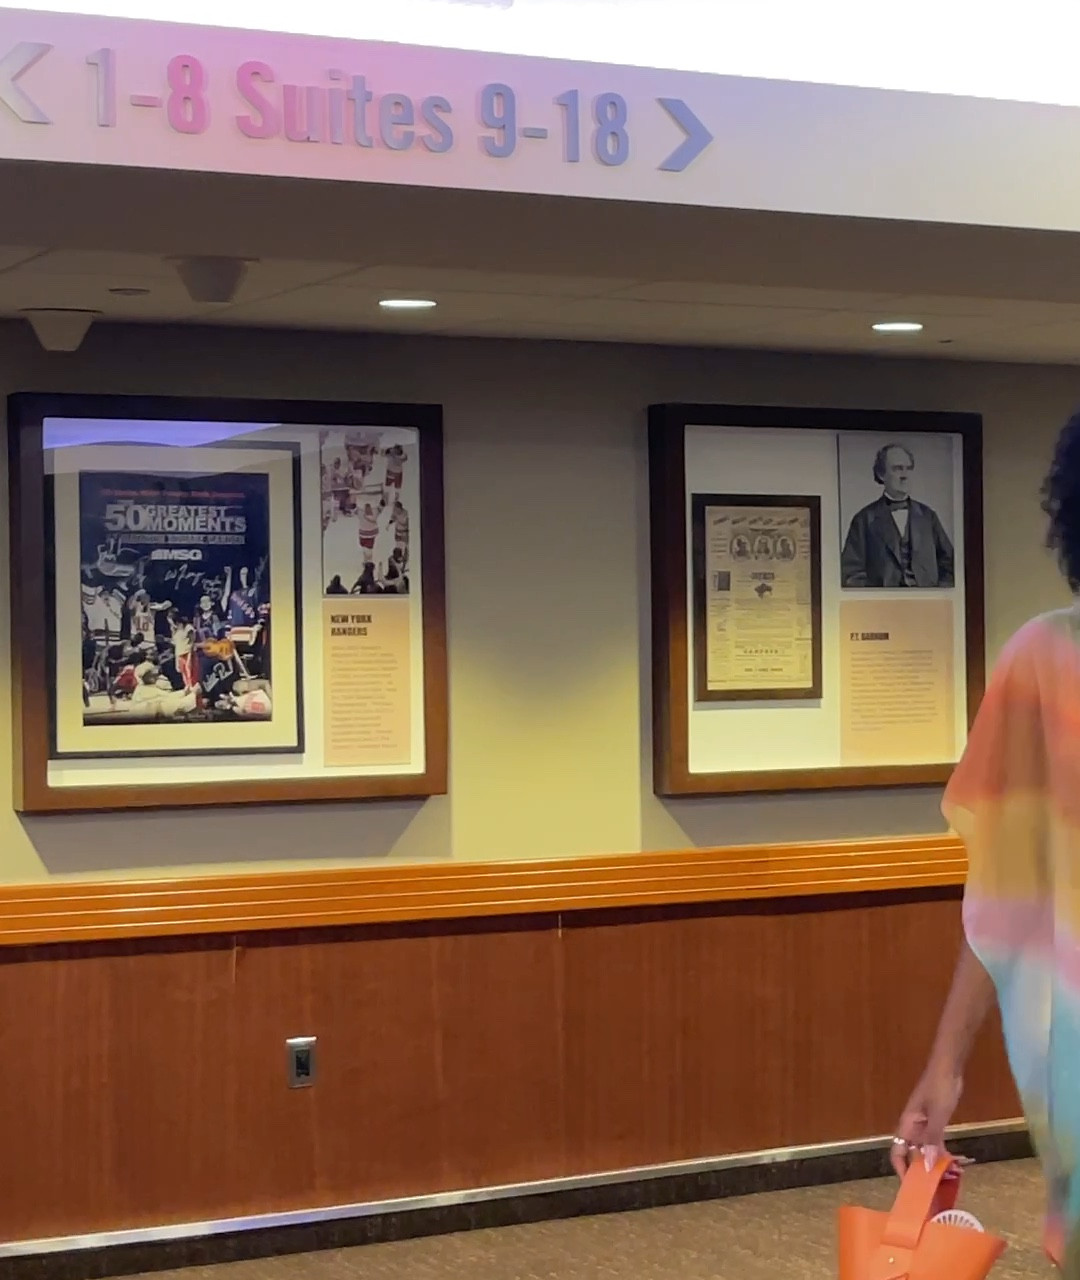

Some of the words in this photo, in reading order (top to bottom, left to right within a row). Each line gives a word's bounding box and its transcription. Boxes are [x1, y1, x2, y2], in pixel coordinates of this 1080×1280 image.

[86, 48, 210, 135] 1-8
[236, 60, 454, 153] Suites
[479, 82, 630, 167] 9-18
[105, 503, 145, 532] 50
[145, 505, 228, 518] GREATEST
[145, 516, 247, 532] MOMENTS
